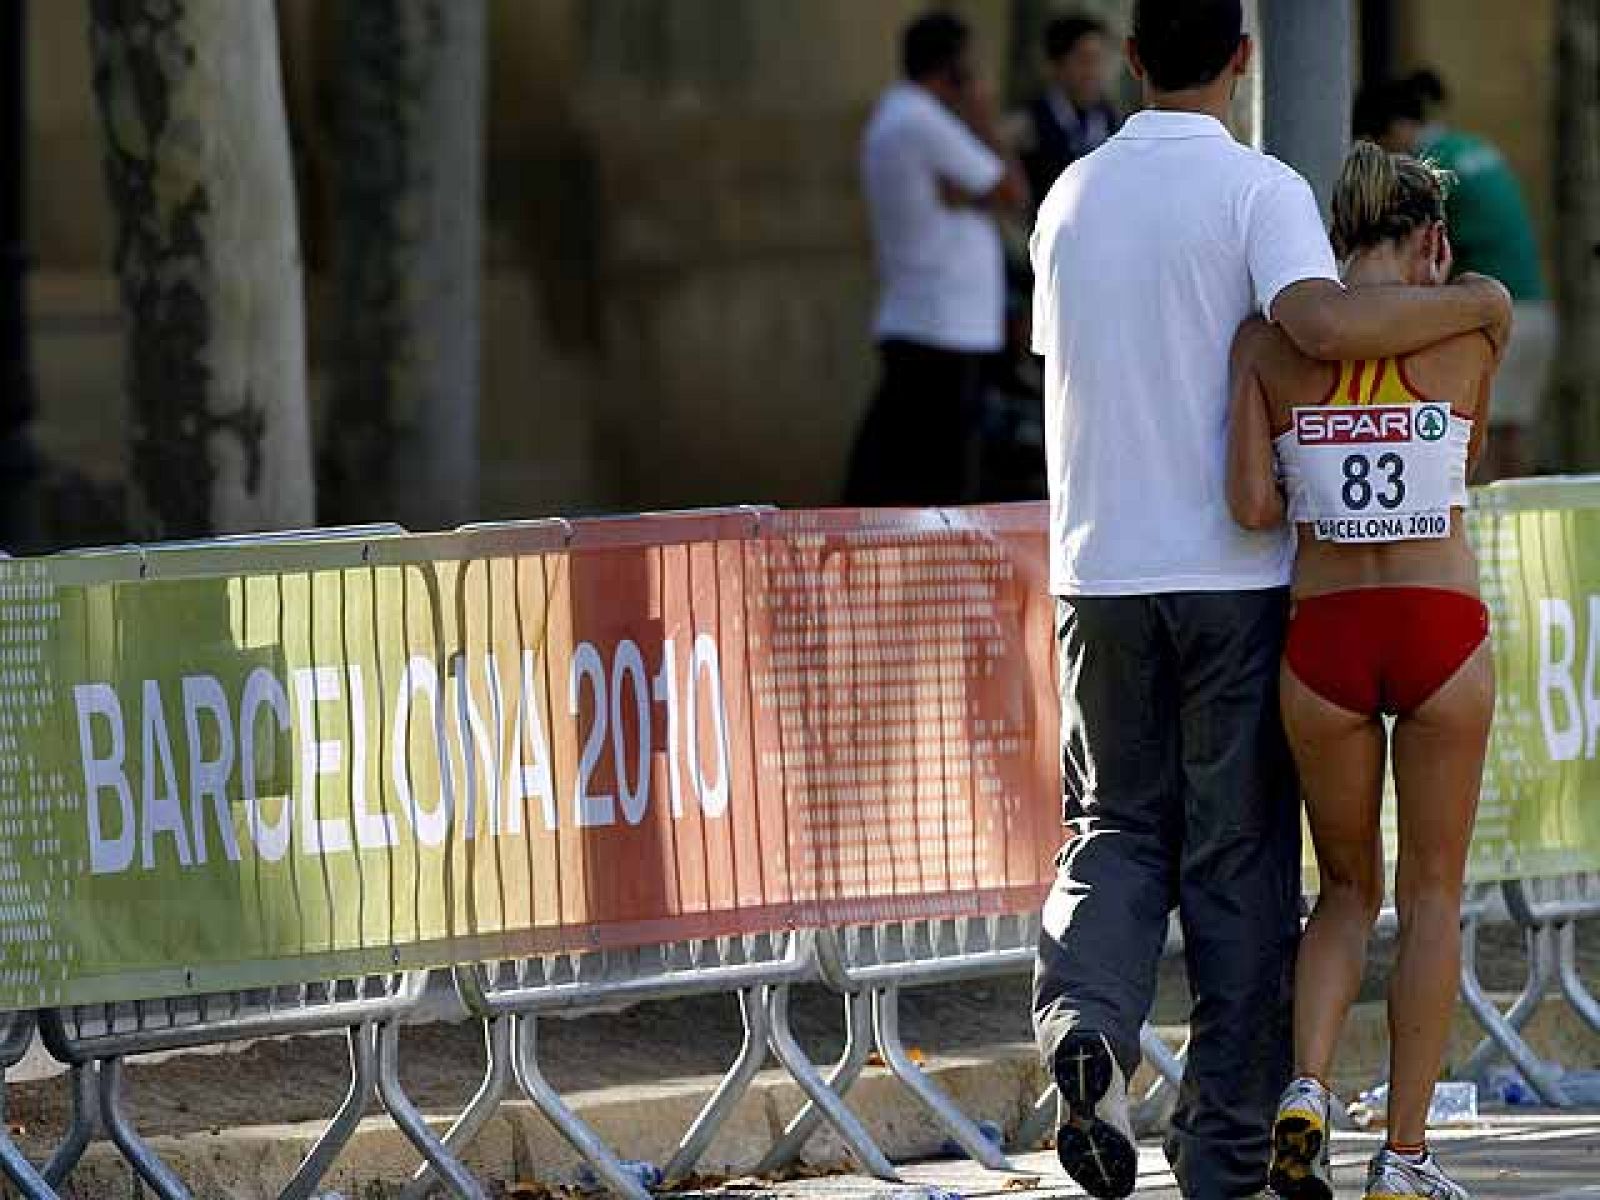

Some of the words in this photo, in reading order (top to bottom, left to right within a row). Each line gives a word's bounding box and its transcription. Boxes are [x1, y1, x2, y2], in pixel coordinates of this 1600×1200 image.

[1300, 413, 1409, 441] SPAR
[1342, 453, 1406, 511] 83
[1317, 519, 1403, 538] CELONA
[1409, 516, 1446, 534] 2010
[74, 650, 558, 875] BARCELONA
[570, 634, 731, 826] 2010
